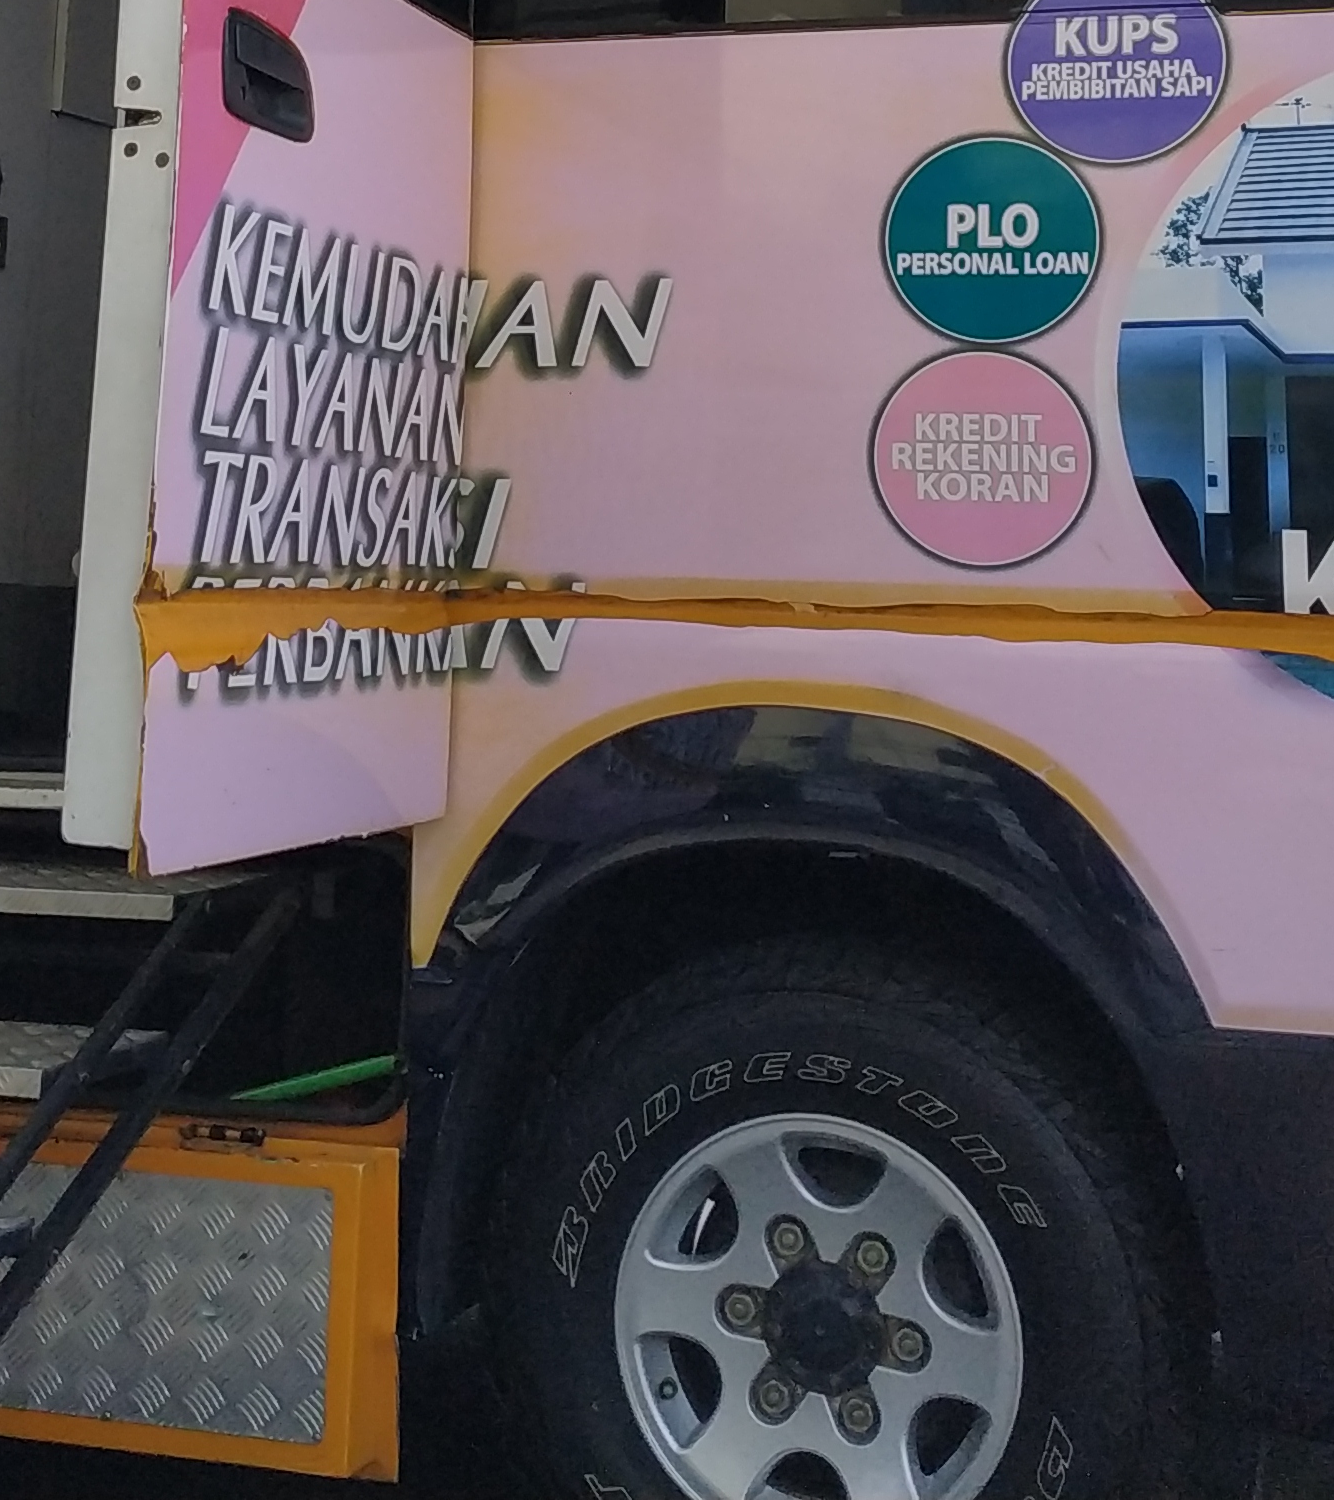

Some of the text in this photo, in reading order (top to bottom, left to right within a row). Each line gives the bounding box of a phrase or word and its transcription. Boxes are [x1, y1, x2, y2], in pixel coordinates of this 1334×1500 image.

[1055, 14, 1180, 58] KUPS
[1031, 58, 1197, 82] KREDIT USAHA
[1021, 75, 1213, 101] PEMBIBITAN SAPI
[947, 202, 1040, 249] PLO
[896, 251, 1089, 276] PERSONAL LOAN
[208, 203, 673, 368] KEMUDAHAN
[200, 326, 465, 466] LAYANAN
[915, 413, 1043, 443] KREDIT
[891, 442, 1077, 473] REKENING
[916, 472, 1049, 503] KORAN
[551, 1051, 1048, 1288] BRIDGESTONE
